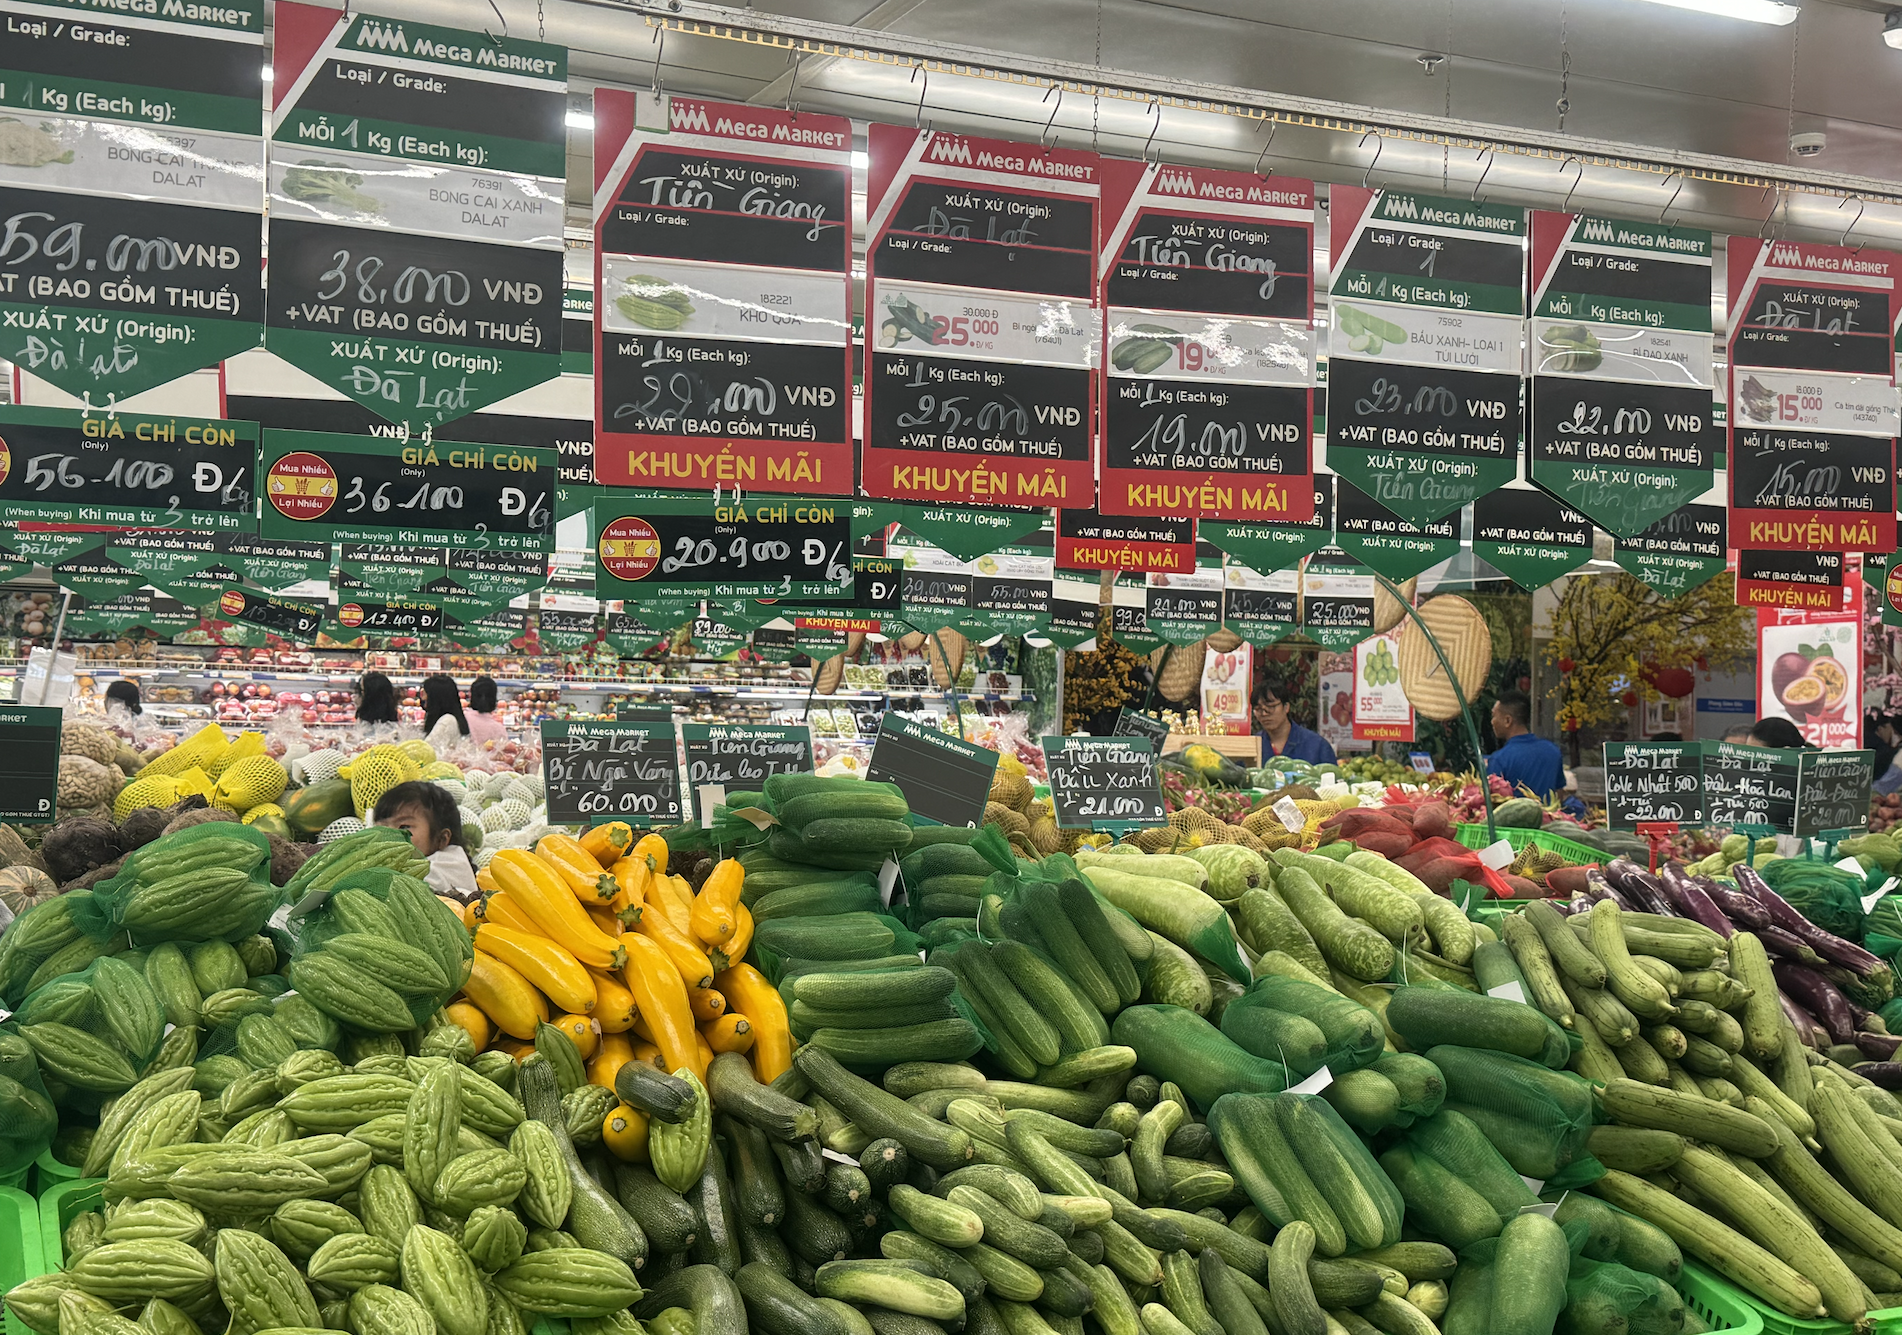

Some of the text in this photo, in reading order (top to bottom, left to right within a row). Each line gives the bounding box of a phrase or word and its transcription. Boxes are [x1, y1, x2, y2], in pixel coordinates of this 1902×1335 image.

[8, 17, 131, 46] Loại / Grade:
[299, 116, 334, 142] MỖI
[368, 132, 391, 153] Kg
[399, 136, 450, 158] (Each
[456, 146, 488, 165] kg):
[153, 171, 205, 188] DALAT
[471, 178, 502, 191] 76391
[429, 189, 542, 214] BONG CAI XANH
[462, 211, 509, 228] DALAT
[173, 242, 240, 270] VNĐ
[482, 278, 542, 305] VNĐ
[760, 294, 792, 305] 182221
[3, 306, 195, 344] XUẤT XỨ (Origin):
[286, 303, 541, 348] +VAT (BAO GỒM THUẾ)
[1438, 317, 1462, 327] 75902
[1435, 348, 1452, 363] TÚI
[1473, 339, 1497, 353] LOẠI
[1034, 404, 1081, 426] VNĐ
[1466, 399, 1506, 419] VNĐ
[82, 417, 235, 447] GIÁ CHỈ CÒN
[1256, 423, 1299, 443] VNĐ
[1664, 414, 1702, 433] VNĐ
[280, 464, 299, 473] Mua
[628, 443, 822, 483] KHUYẾN MÃI
[401, 468, 425, 478] (Only)
[893, 459, 1066, 498] KHUYẾN MÃI
[1851, 467, 1885, 484] VNĐ
[278, 499, 295, 508] Lợi
[1128, 476, 1287, 512] KHUYẾN MÃI
[5, 508, 35, 518] (When
[38, 509, 72, 520] buying)
[79, 509, 101, 520] Khi
[106, 511, 134, 522] mua
[219, 511, 238, 527] lên
[923, 509, 1011, 527] XUẤT XỨ (Origin):
[1750, 514, 1876, 545] KHUYẾN MÃI
[1074, 543, 1178, 568] KHUYẾN MÃI
[1538, 549, 1569, 559] (Origin):
[1646, 540, 1668, 550] (BAO
[1693, 542, 1719, 556] THUẾ)
[1030, 590, 1047, 598] VNĐ
[1750, 585, 1831, 607] KHUYẾN MÃI
[669, 802, 678, 814] Đ
[1695, 810, 1702, 819] Đ
